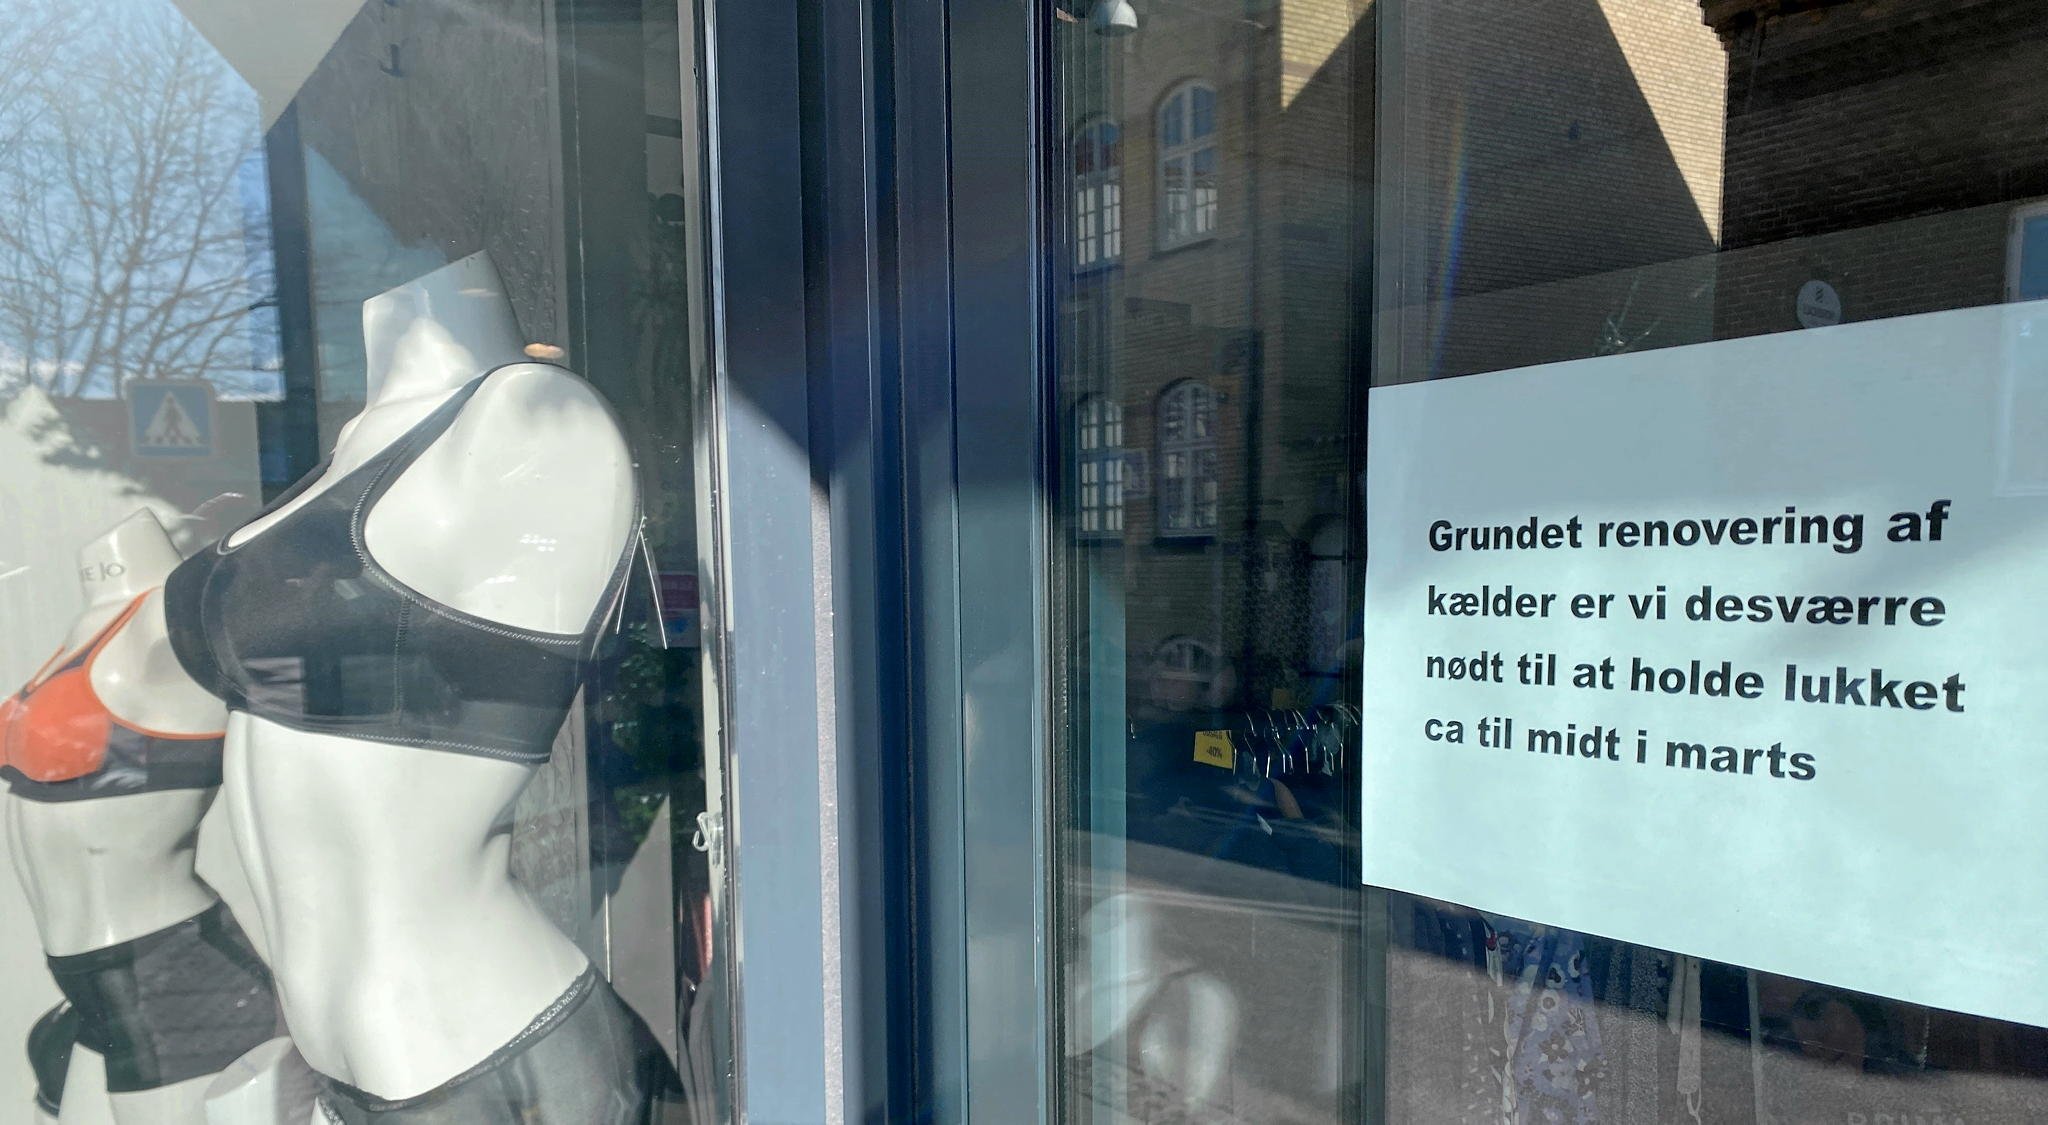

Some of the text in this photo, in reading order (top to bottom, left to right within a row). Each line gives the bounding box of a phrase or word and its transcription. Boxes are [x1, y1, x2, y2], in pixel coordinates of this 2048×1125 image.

[1428, 499, 1952, 555] Grundet renovering af
[1428, 584, 1946, 627] kælder er vi desværre
[1426, 650, 1966, 713] nødt til at holde lukket
[1424, 716, 1816, 781] ca til midt i marts
